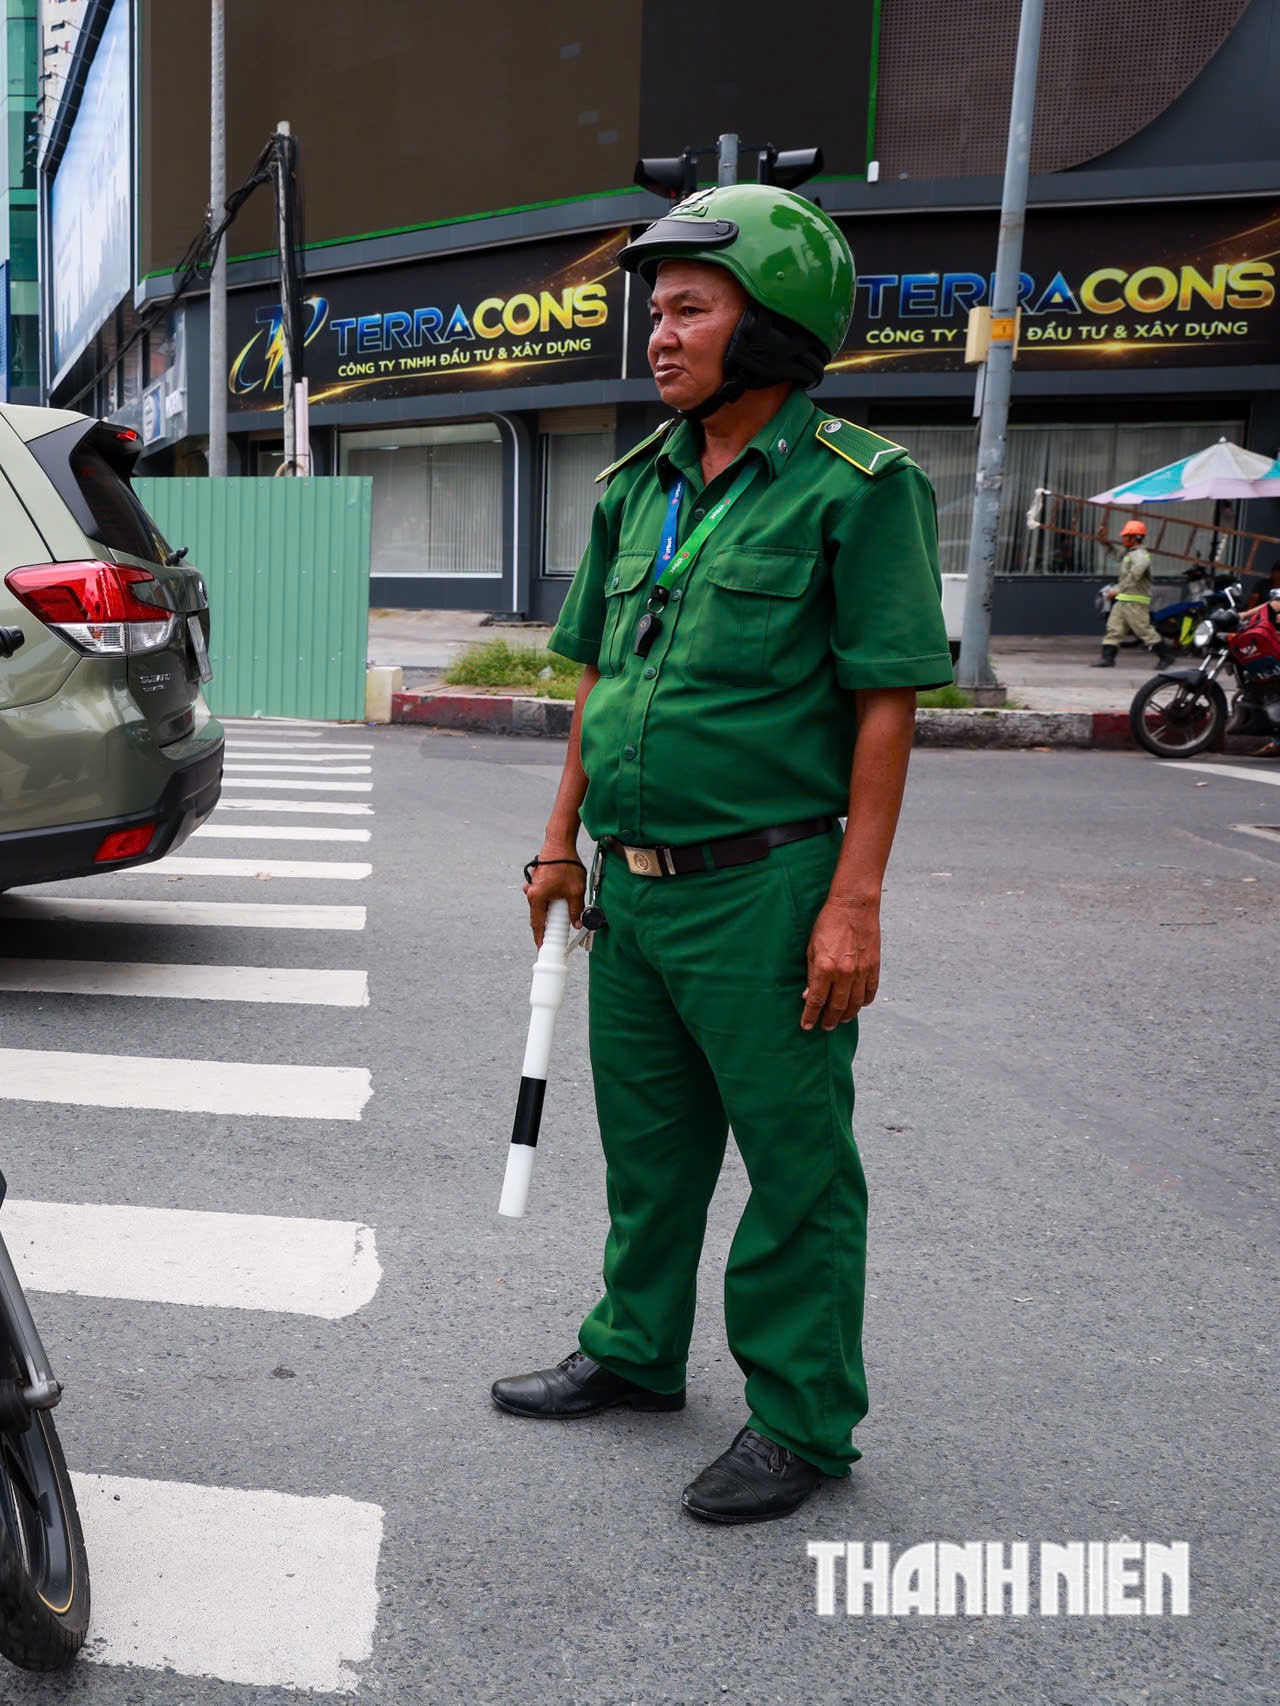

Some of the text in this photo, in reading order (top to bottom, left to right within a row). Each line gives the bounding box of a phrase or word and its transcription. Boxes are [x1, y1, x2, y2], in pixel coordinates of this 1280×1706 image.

[856, 262, 1276, 319] TERRACONS
[330, 283, 608, 356] TERRACONS
[866, 327, 958, 344] CÔNG TY
[1078, 324, 1108, 340] TƯ
[1113, 324, 1128, 340] &
[1134, 320, 1180, 338] XÂY
[1185, 320, 1249, 340] DỰNG
[338, 362, 375, 377] CÔNG
[379, 360, 396, 372] TY
[399, 355, 437, 370] TNHH
[474, 347, 495, 362] TƯ
[497, 347, 508, 360] &
[512, 341, 543, 358] XÂY
[546, 338, 592, 357] DỰNG
